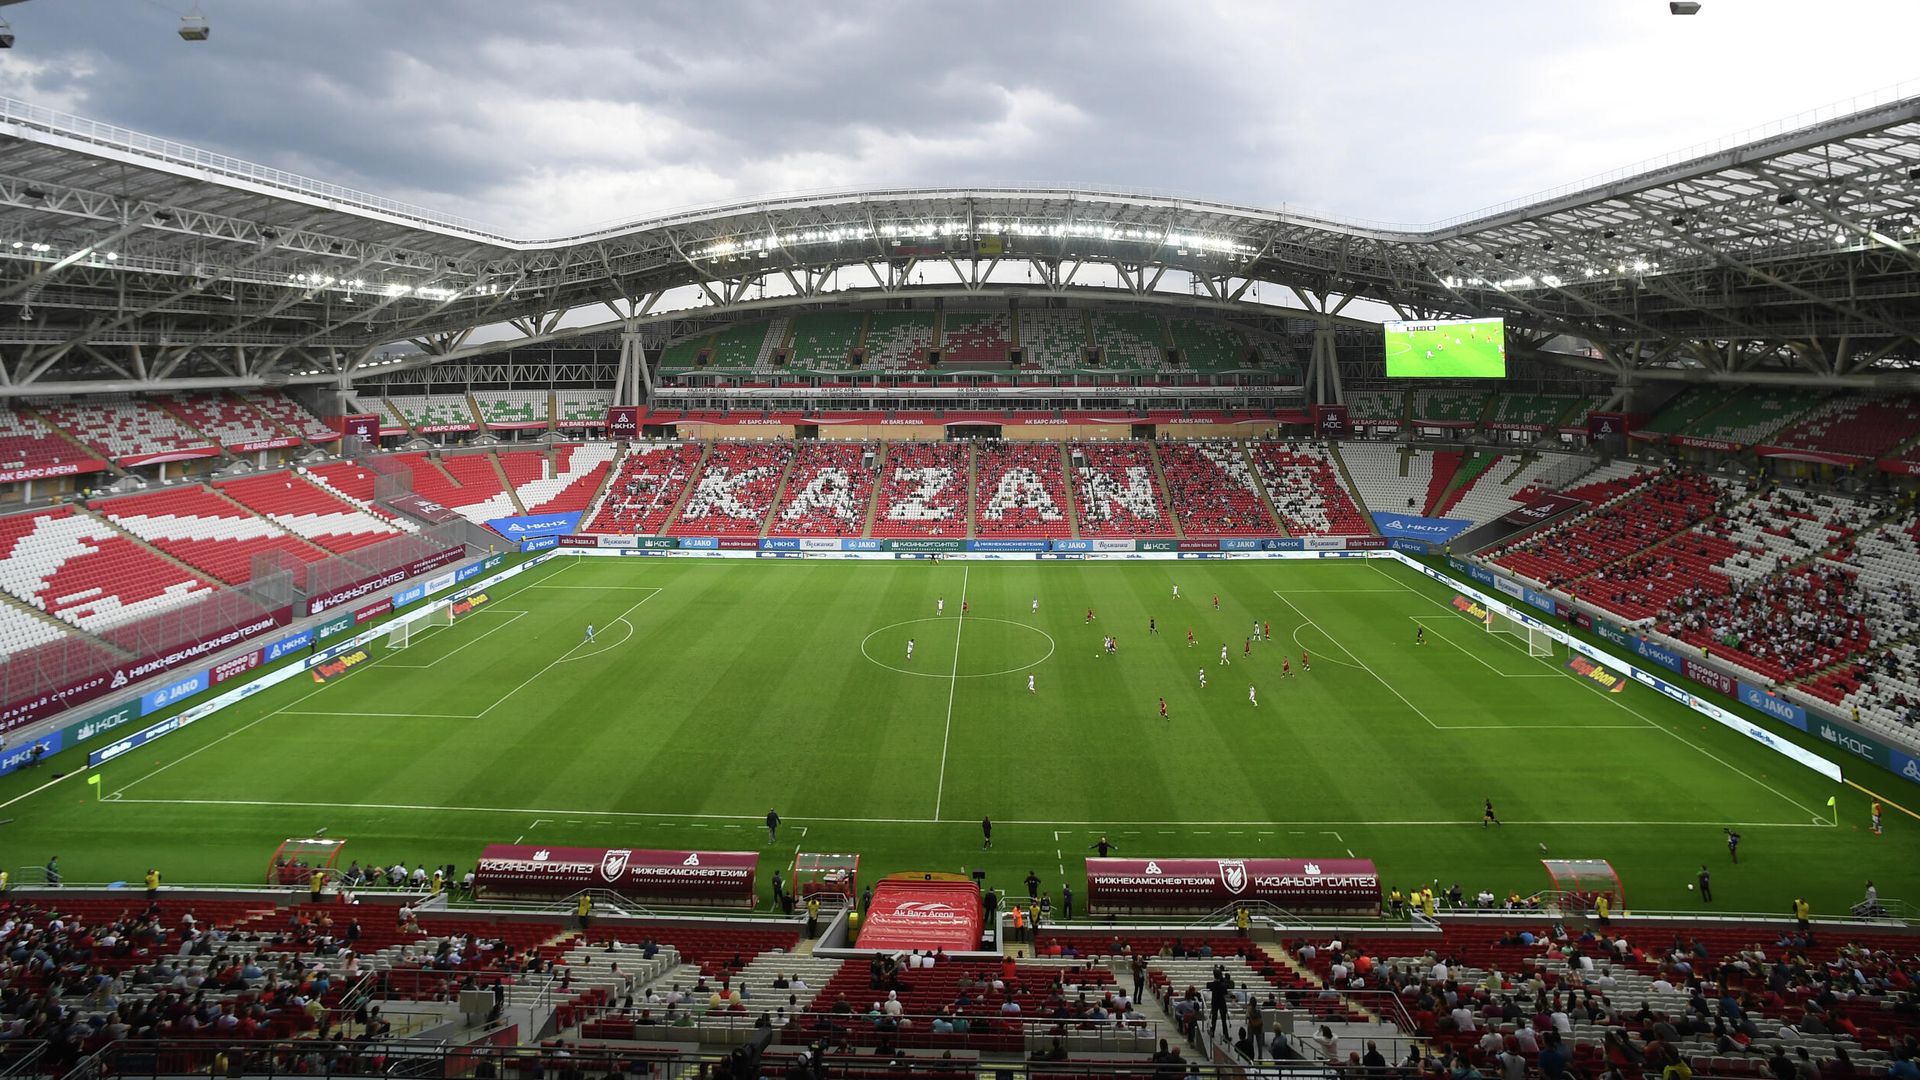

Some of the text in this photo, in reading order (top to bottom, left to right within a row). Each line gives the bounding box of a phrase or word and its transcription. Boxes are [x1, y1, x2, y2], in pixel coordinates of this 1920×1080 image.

[1323, 421, 1342, 429] КОС
[1692, 440, 1707, 448] БАРС
[1708, 441, 1729, 450] АРЕНА
[0, 464, 79, 481] АК БАРС АРЕНА
[526, 520, 568, 530] НКНХ
[1406, 523, 1449, 532] НКНХ
[535, 539, 555, 548] НКНХ
[693, 539, 712, 547] JAKO
[1401, 543, 1421, 551] НКНХ
[323, 571, 405, 608] КАЗАНЬОРГСИНТЕЗ
[405, 588, 421, 601] JAKO
[1535, 597, 1550, 609] JAKO
[329, 620, 348, 634] КОС
[282, 635, 308, 652] НКНХ
[1606, 631, 1625, 646] КОС
[129, 617, 274, 679] НИЖНЕКАМСКНЕФТЕХИМ
[1649, 650, 1675, 667] НКНХ
[51, 678, 104, 702] СПОНСОР
[169, 679, 199, 700] JAKO
[1763, 697, 1794, 720] JAKO
[95, 710, 129, 733] КОС
[1838, 733, 1874, 760] КОС
[479, 861, 595, 874] КАЗАНЬОРГСИНТЕЗ
[631, 867, 748, 877] НИЖНЕКАМСКНЕФТЕХИМ
[1095, 877, 1215, 885] НИЖНЕКАМСКНЕФТЕХИМ
[1255, 876, 1377, 887] КАЗАНЬОРГСИНТЕЗ
[893, 909, 954, 918] Ak Bars Arena
